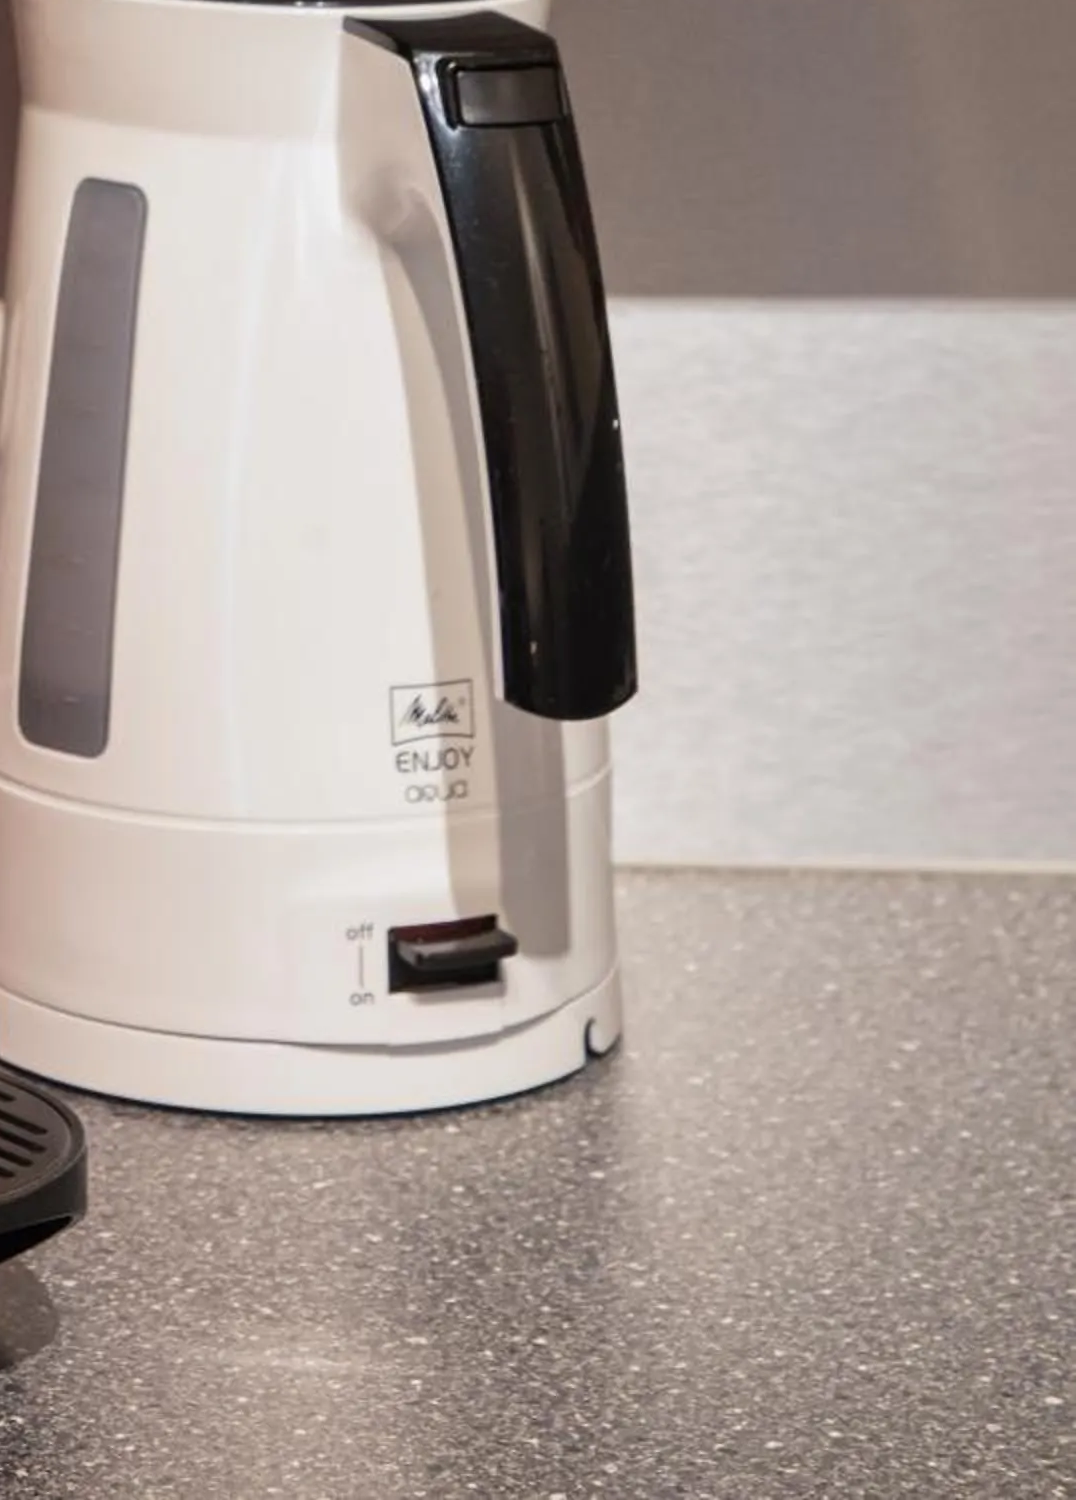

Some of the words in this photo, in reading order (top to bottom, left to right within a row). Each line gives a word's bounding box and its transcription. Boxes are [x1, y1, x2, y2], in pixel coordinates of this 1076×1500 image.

[395, 747, 475, 774] ENJOY
[345, 921, 374, 941] off
[349, 990, 375, 1007] on
